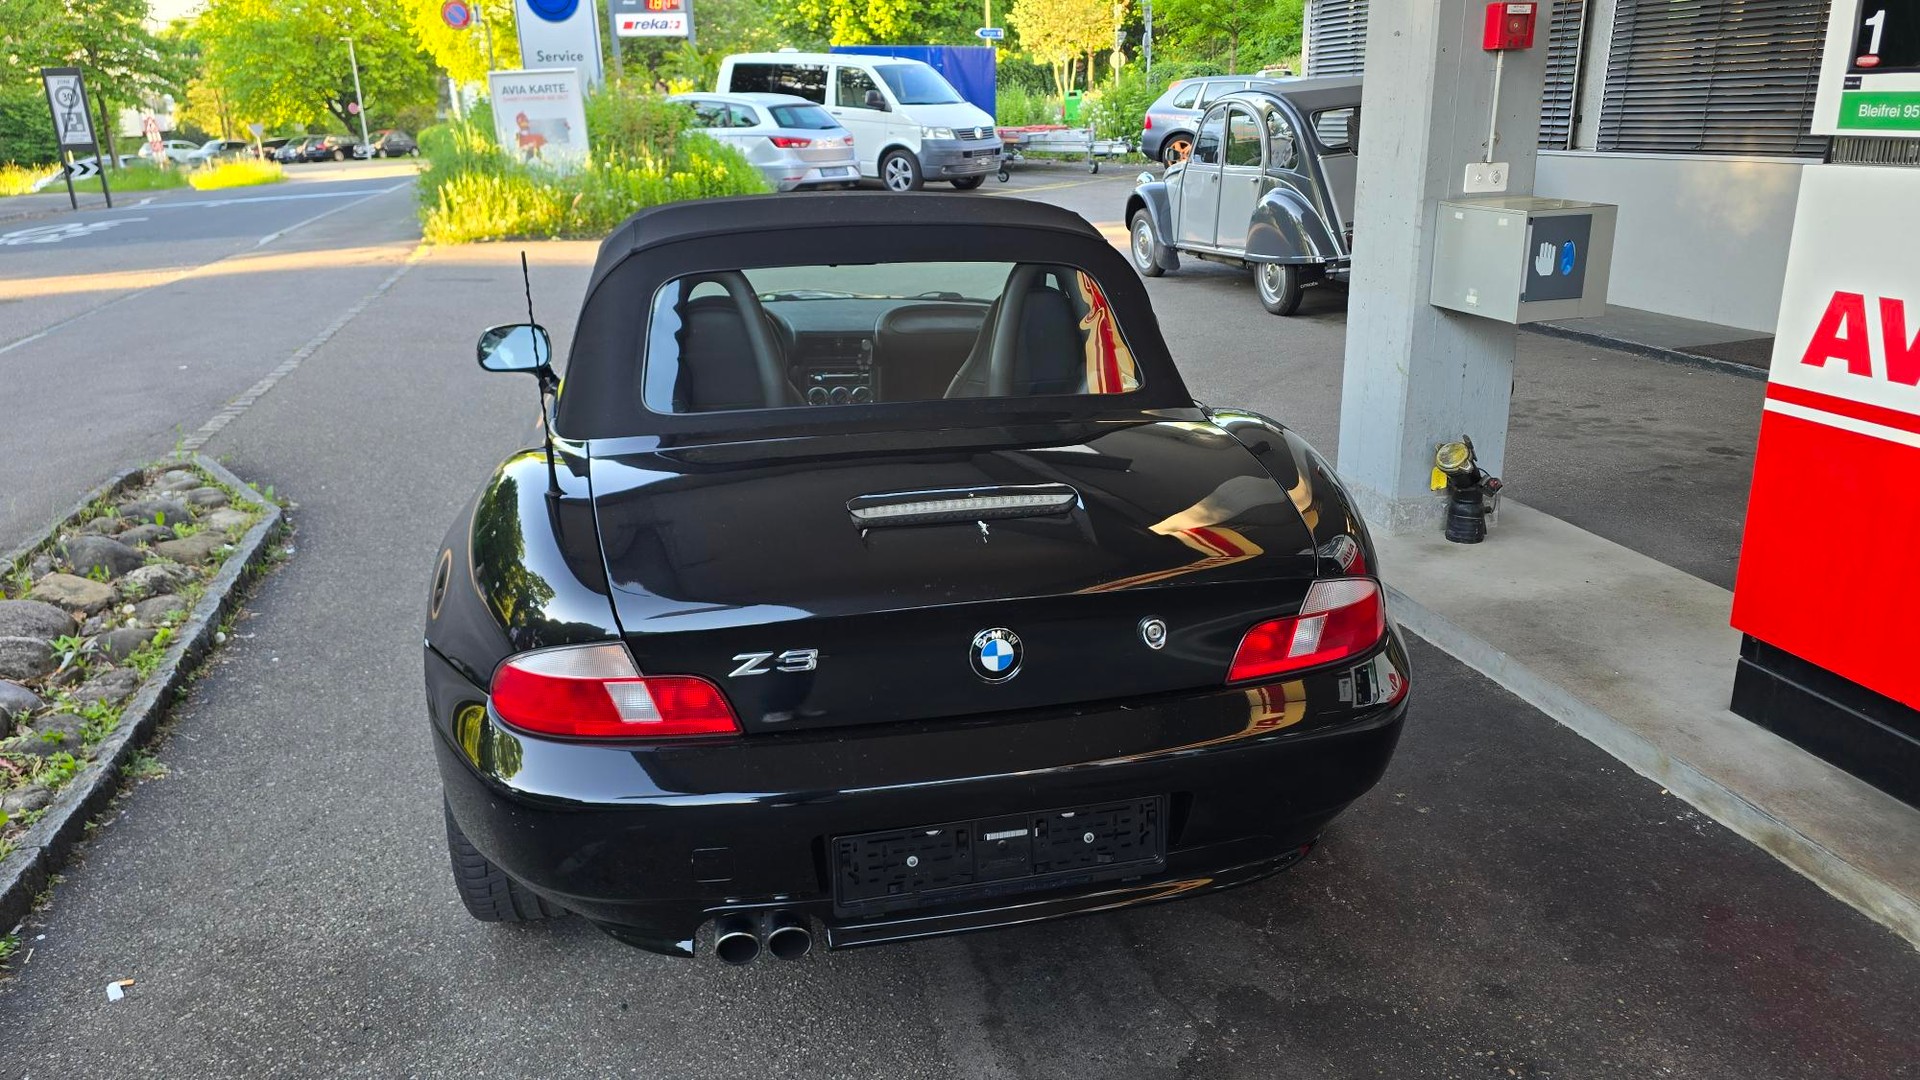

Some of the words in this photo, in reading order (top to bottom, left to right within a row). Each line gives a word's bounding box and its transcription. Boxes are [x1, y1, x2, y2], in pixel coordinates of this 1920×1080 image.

[1865, 9, 1886, 54] 1
[537, 50, 584, 62] Service
[502, 85, 527, 95] AVIA
[1858, 104, 1901, 117] Bleifrei
[1903, 104, 1920, 118] 95
[975, 630, 1019, 649] BMW
[728, 649, 819, 677] Z3
